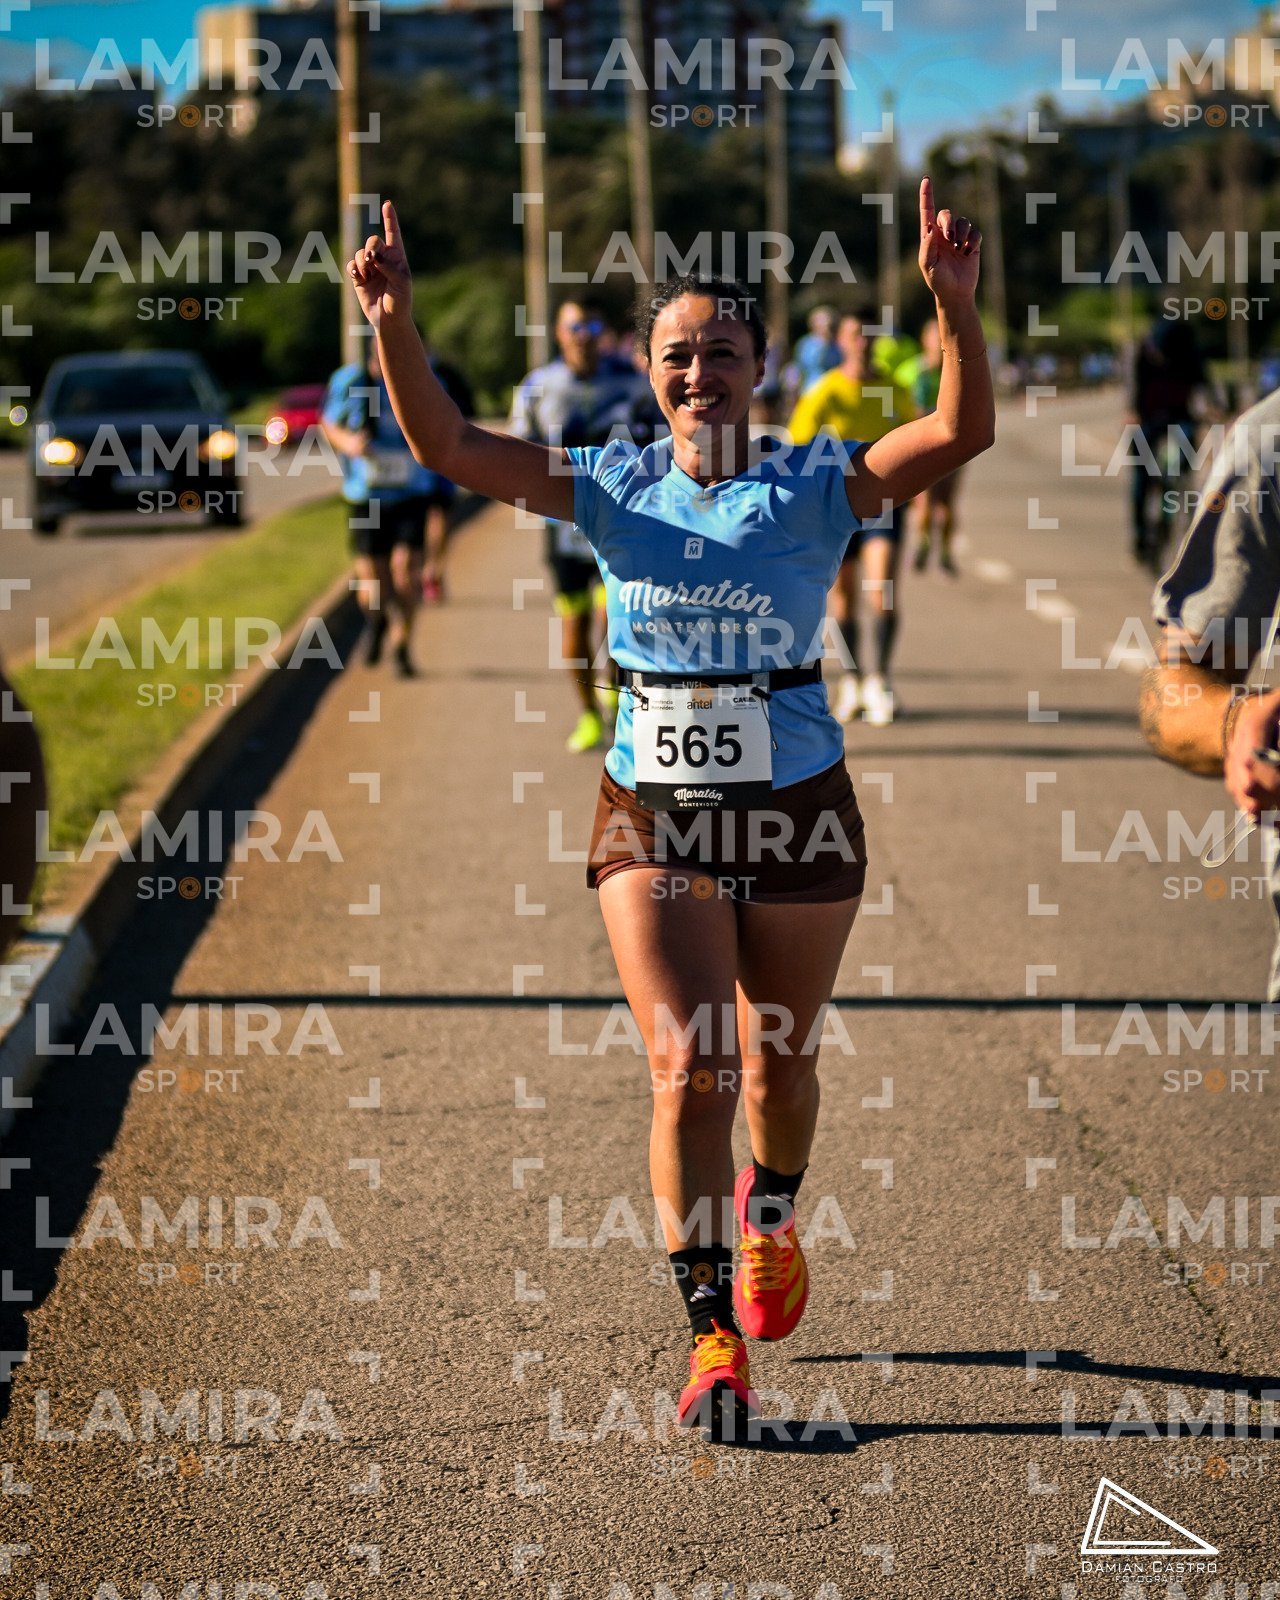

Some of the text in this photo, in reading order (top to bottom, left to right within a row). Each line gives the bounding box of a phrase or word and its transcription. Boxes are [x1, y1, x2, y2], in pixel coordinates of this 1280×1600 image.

[618, 576, 774, 617] Maratón
[632, 621, 758, 636] MONTEVIDEO
[656, 724, 742, 769] 565
[673, 787, 724, 801] Maratón
